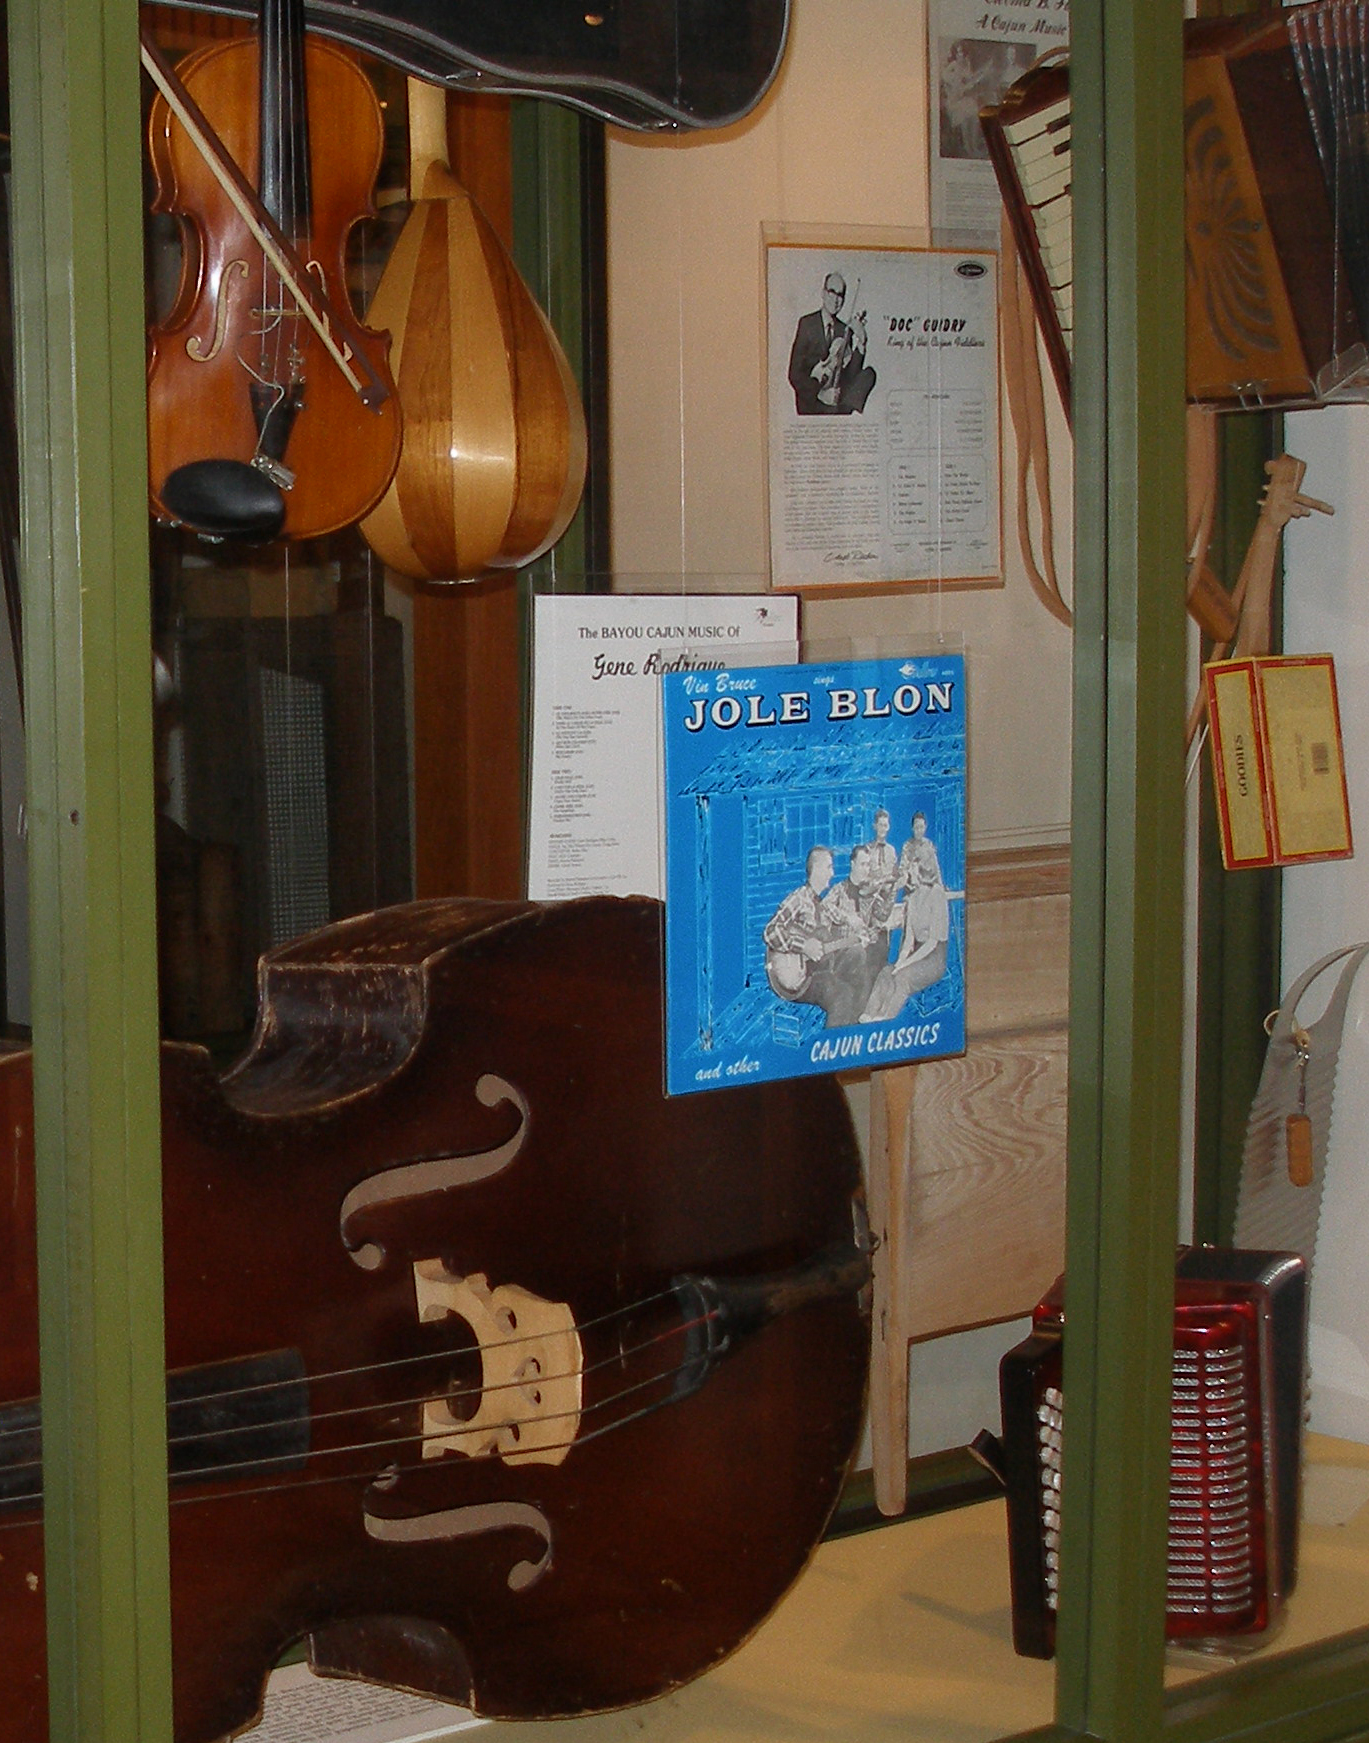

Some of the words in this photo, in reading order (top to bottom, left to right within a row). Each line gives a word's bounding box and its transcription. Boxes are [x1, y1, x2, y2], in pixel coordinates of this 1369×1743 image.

[991, 15, 1026, 35] Cajun
[1030, 19, 1067, 36] Music
[883, 315, 921, 332] "DOC"
[923, 318, 967, 332] GUIDRY
[578, 627, 598, 640] The
[601, 627, 643, 639] BAYOU
[646, 626, 685, 639] CAJUN
[688, 626, 724, 639] MUSIC
[727, 625, 741, 638] Of
[591, 653, 637, 681] Gene
[683, 675, 710, 696] Vin
[715, 672, 758, 693] Bruce
[684, 692, 810, 733] JOLE
[827, 682, 956, 723] BLON
[810, 1034, 864, 1063] CAJUN
[867, 1021, 941, 1054] CLASSICS
[694, 1061, 723, 1082] and
[726, 1055, 762, 1077] other
